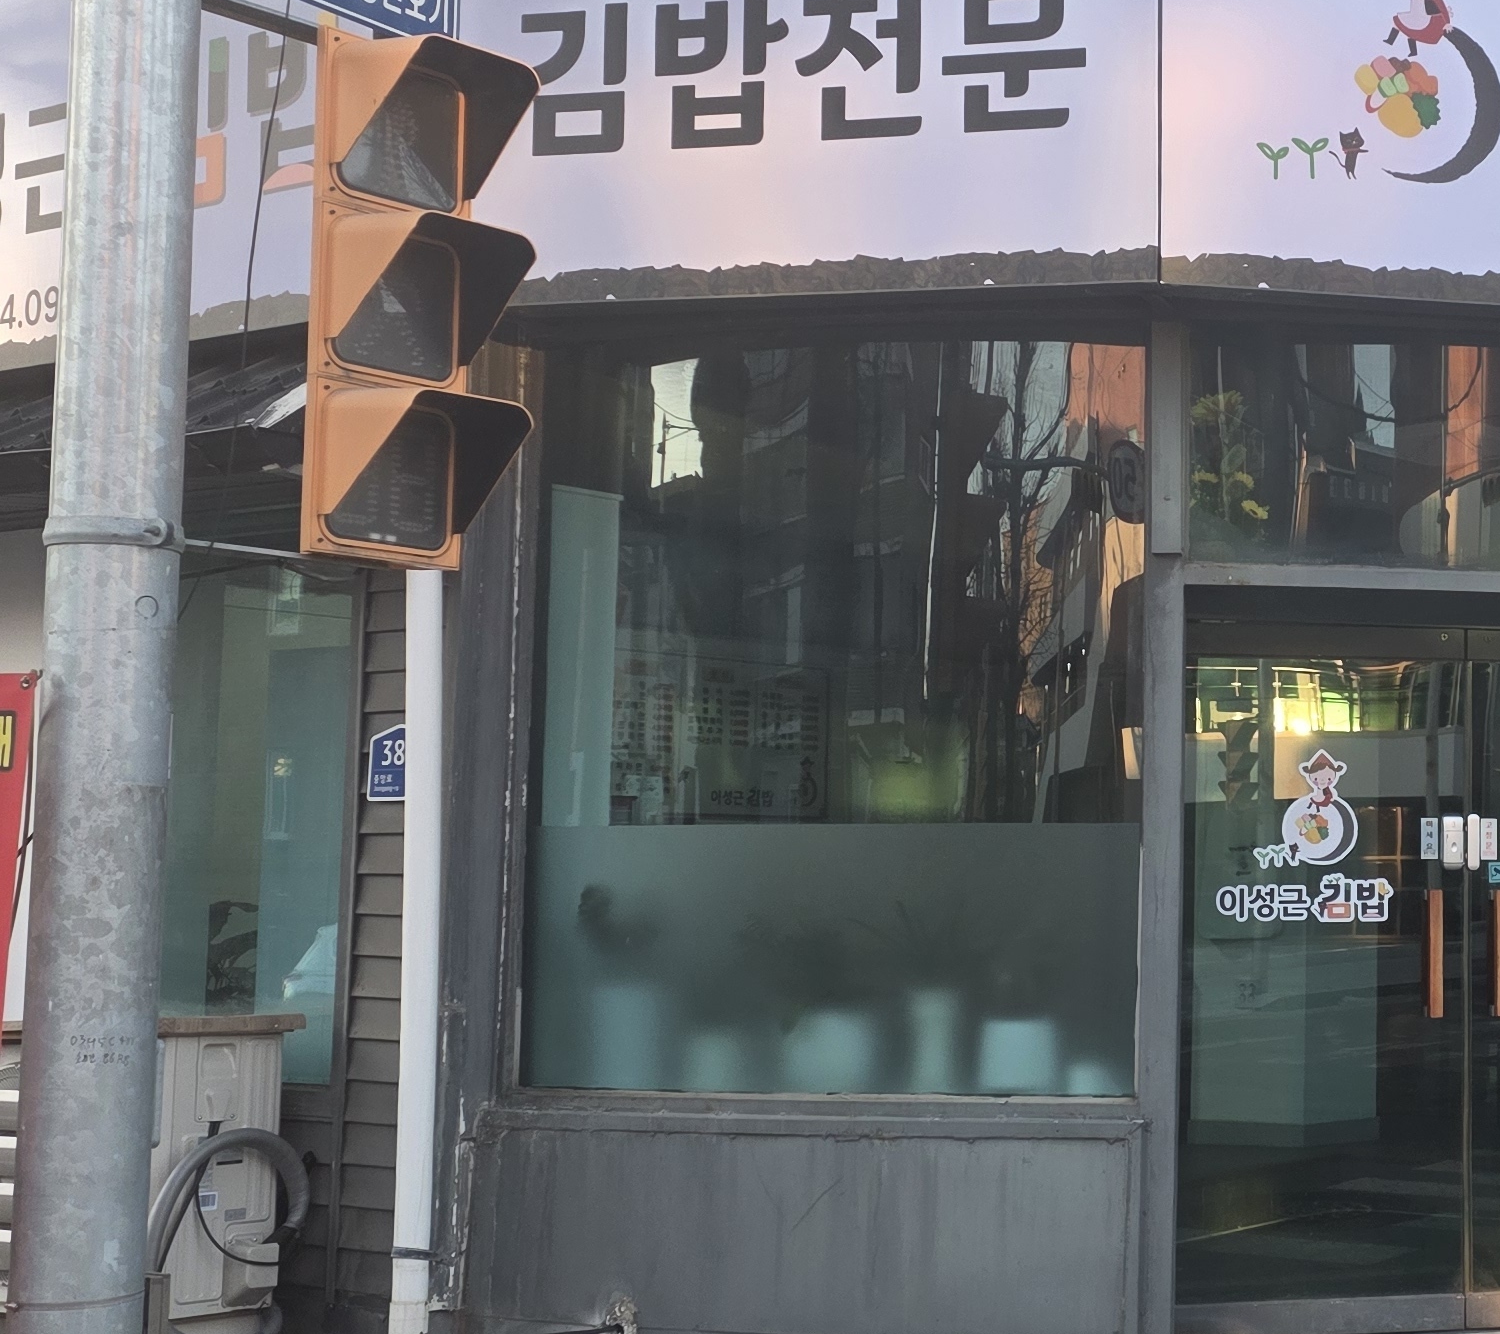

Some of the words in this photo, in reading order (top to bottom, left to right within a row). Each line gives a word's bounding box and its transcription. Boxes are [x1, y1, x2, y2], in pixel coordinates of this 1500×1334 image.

[381, 739, 405, 766] 38
[1218, 886, 1310, 920] 이성근
[1317, 877, 1391, 921] 김밥
